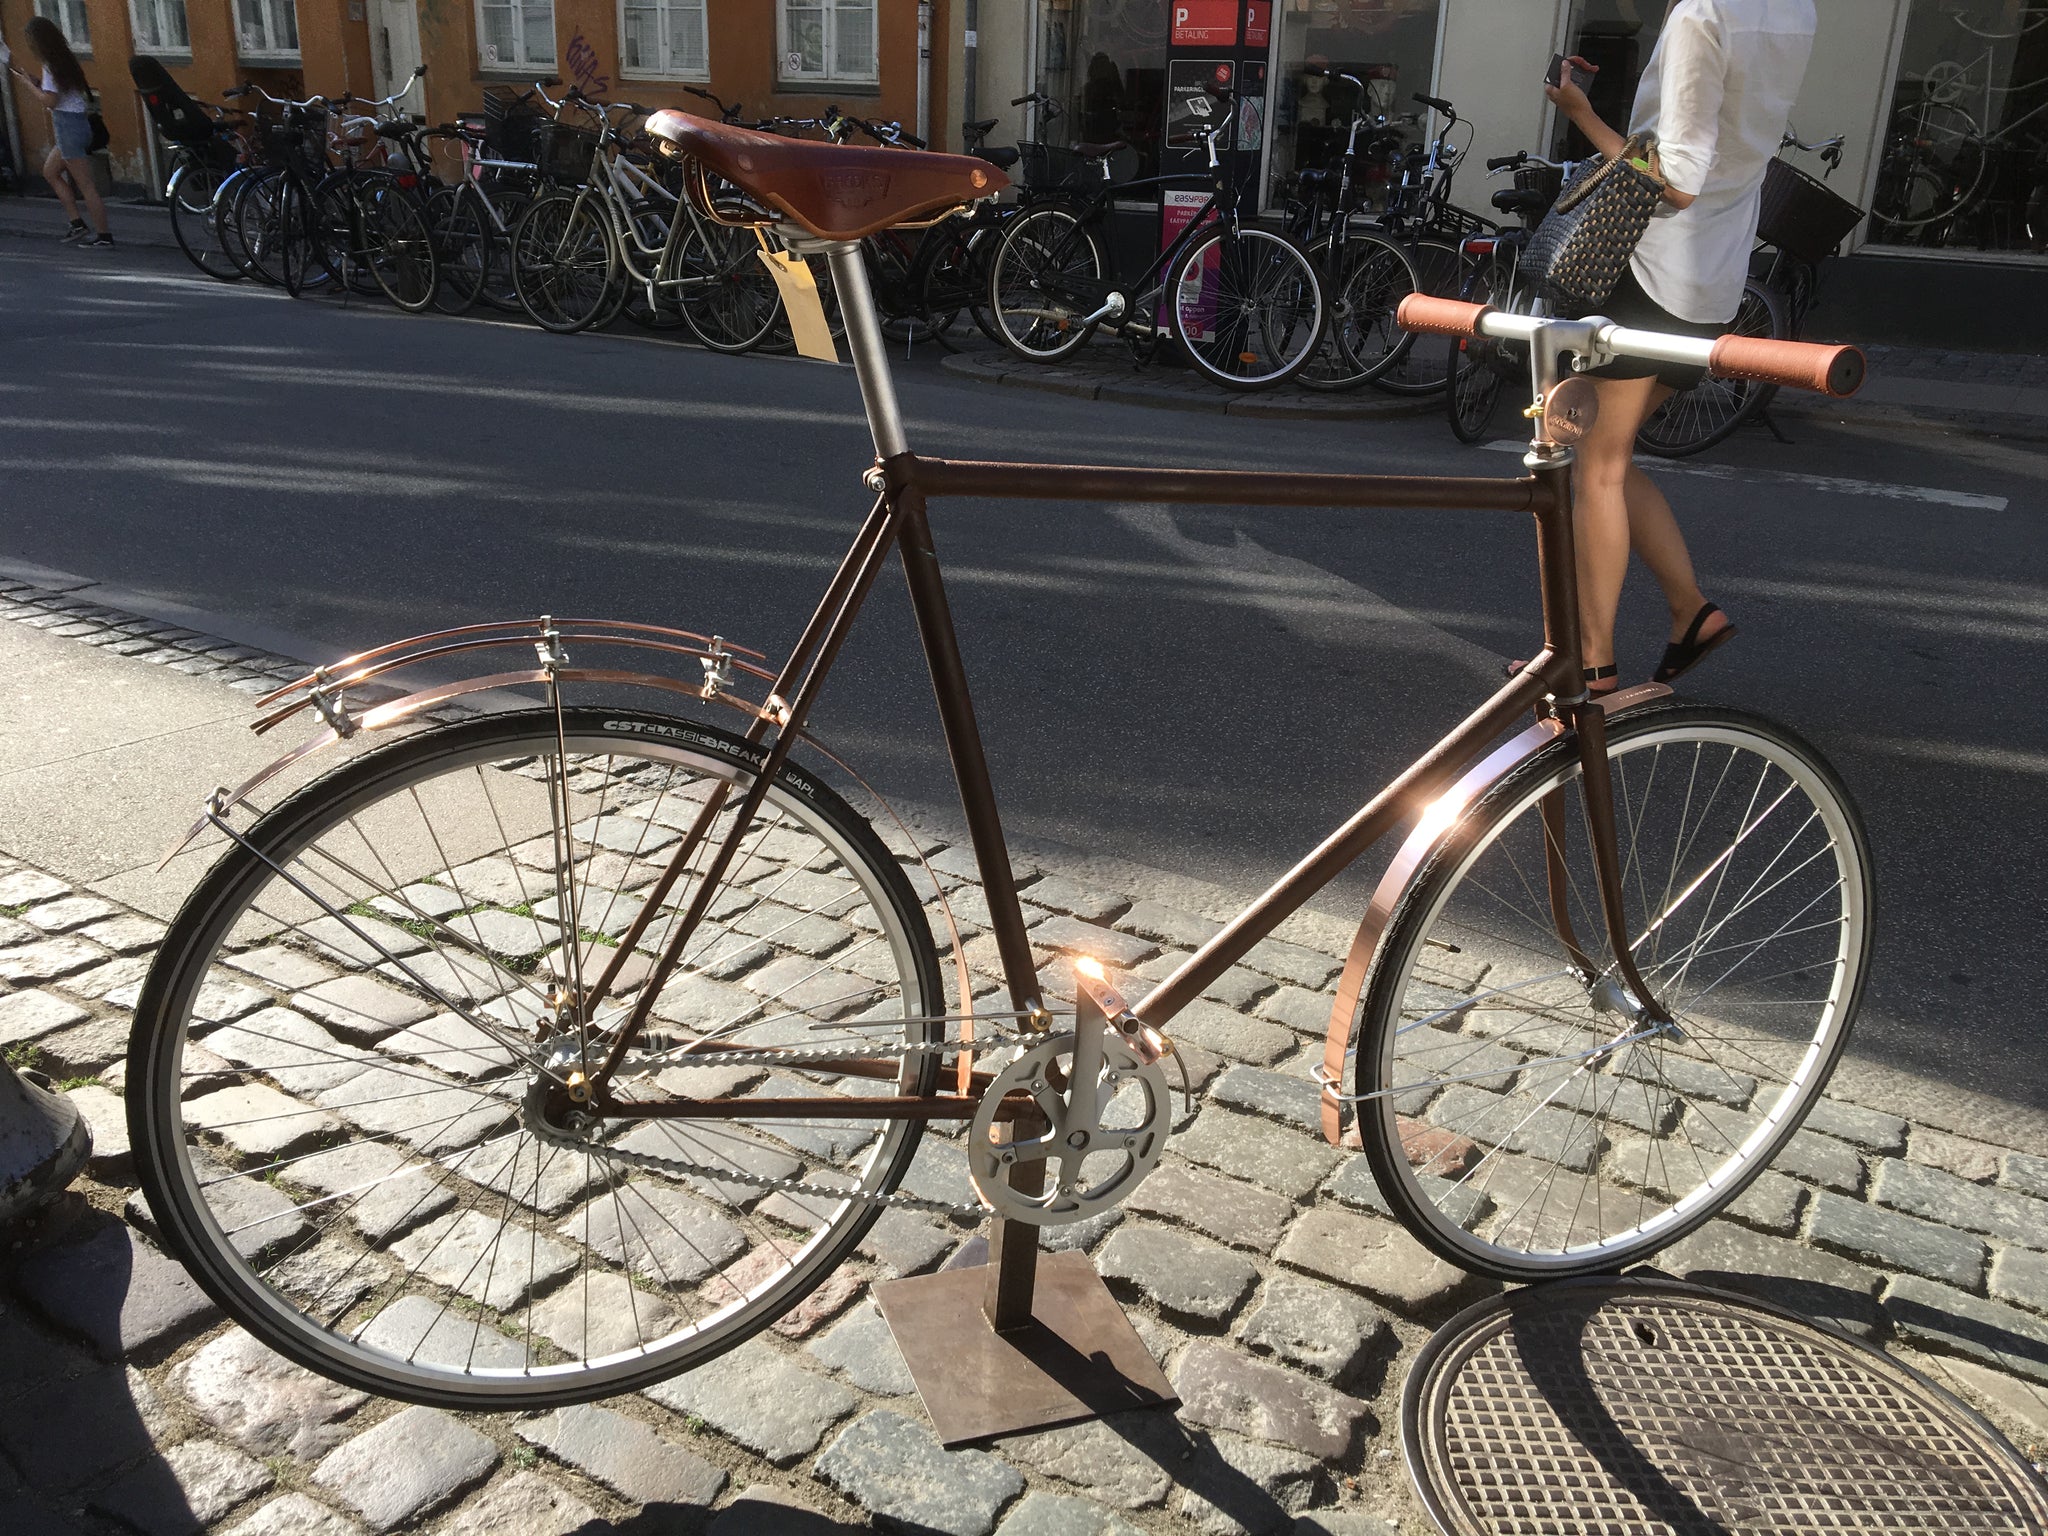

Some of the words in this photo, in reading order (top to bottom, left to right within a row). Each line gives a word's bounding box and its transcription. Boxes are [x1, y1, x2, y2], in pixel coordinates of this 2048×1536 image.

[1176, 8, 1188, 27] P
[1247, 8, 1255, 27] P
[1175, 30, 1209, 39] BETALING
[1174, 194, 1209, 203] easypar
